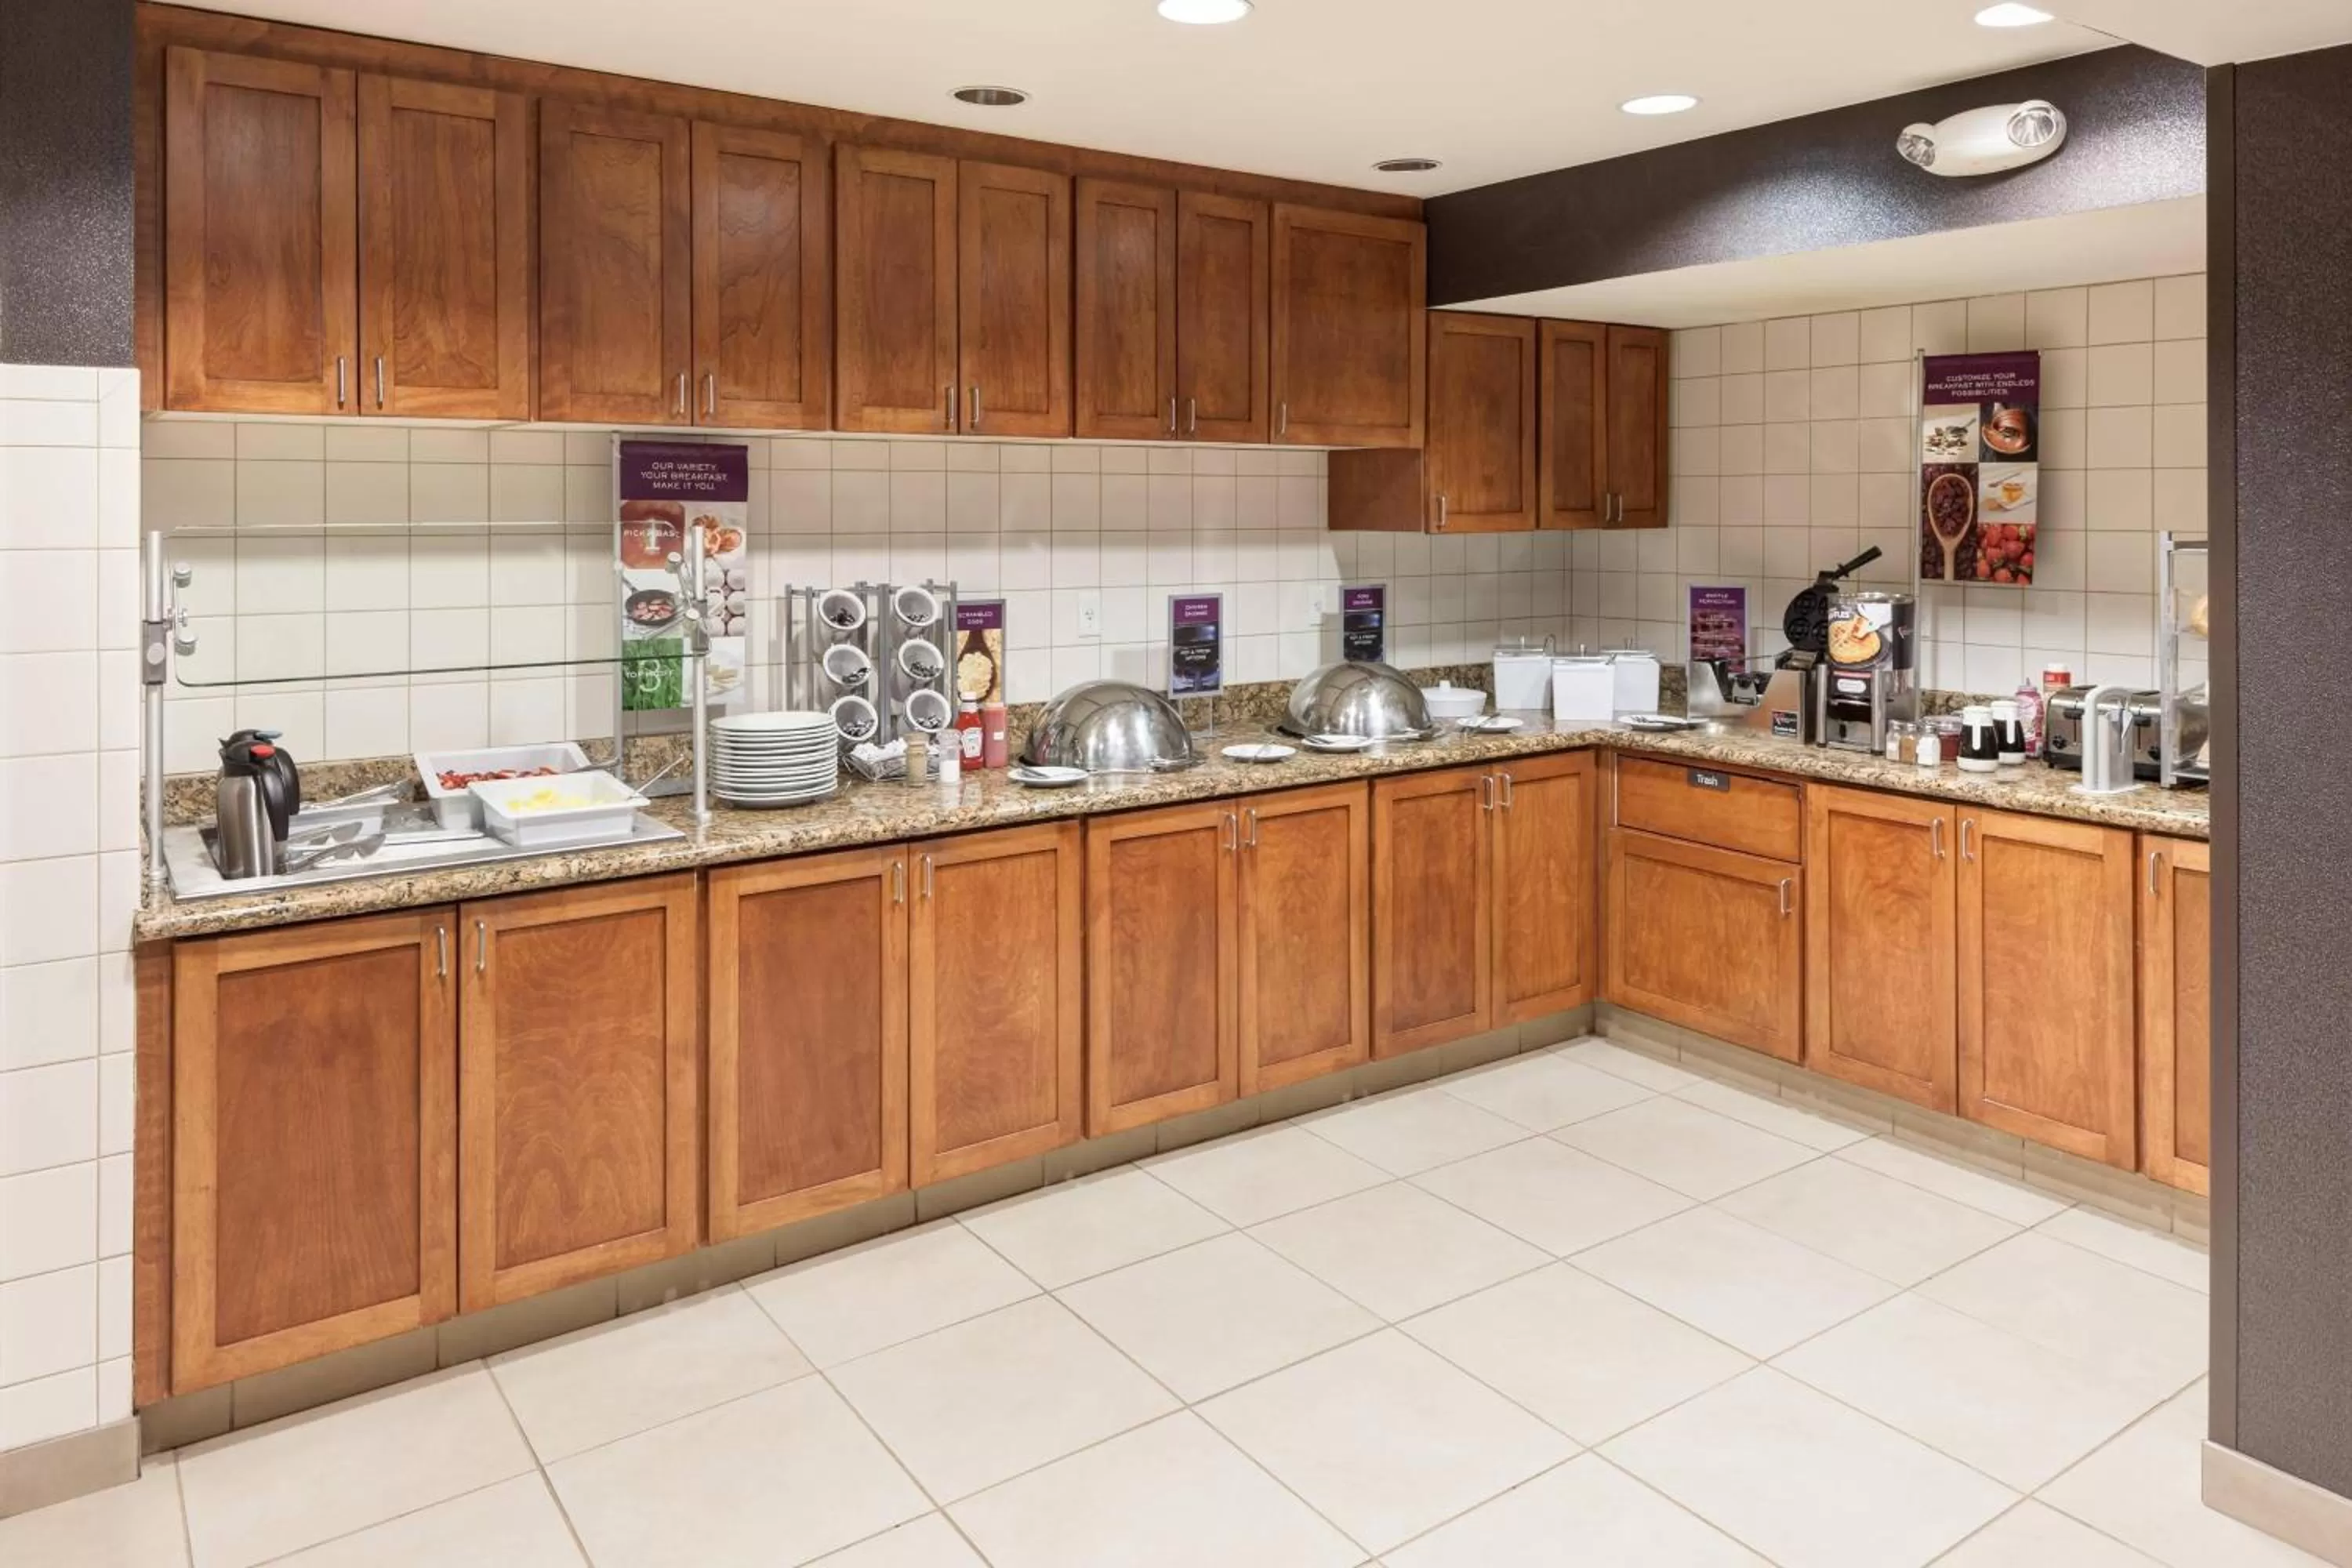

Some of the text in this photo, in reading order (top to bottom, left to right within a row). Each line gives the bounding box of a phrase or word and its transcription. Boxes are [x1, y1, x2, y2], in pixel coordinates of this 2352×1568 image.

[1928, 382, 1973, 390] BREAKFAST
[1997, 379, 2035, 387] ENDLESS
[652, 462, 673, 470] OUR
[641, 471, 667, 480] YOUR
[623, 529, 645, 538] PICK
[1696, 774, 1719, 786] Trash
